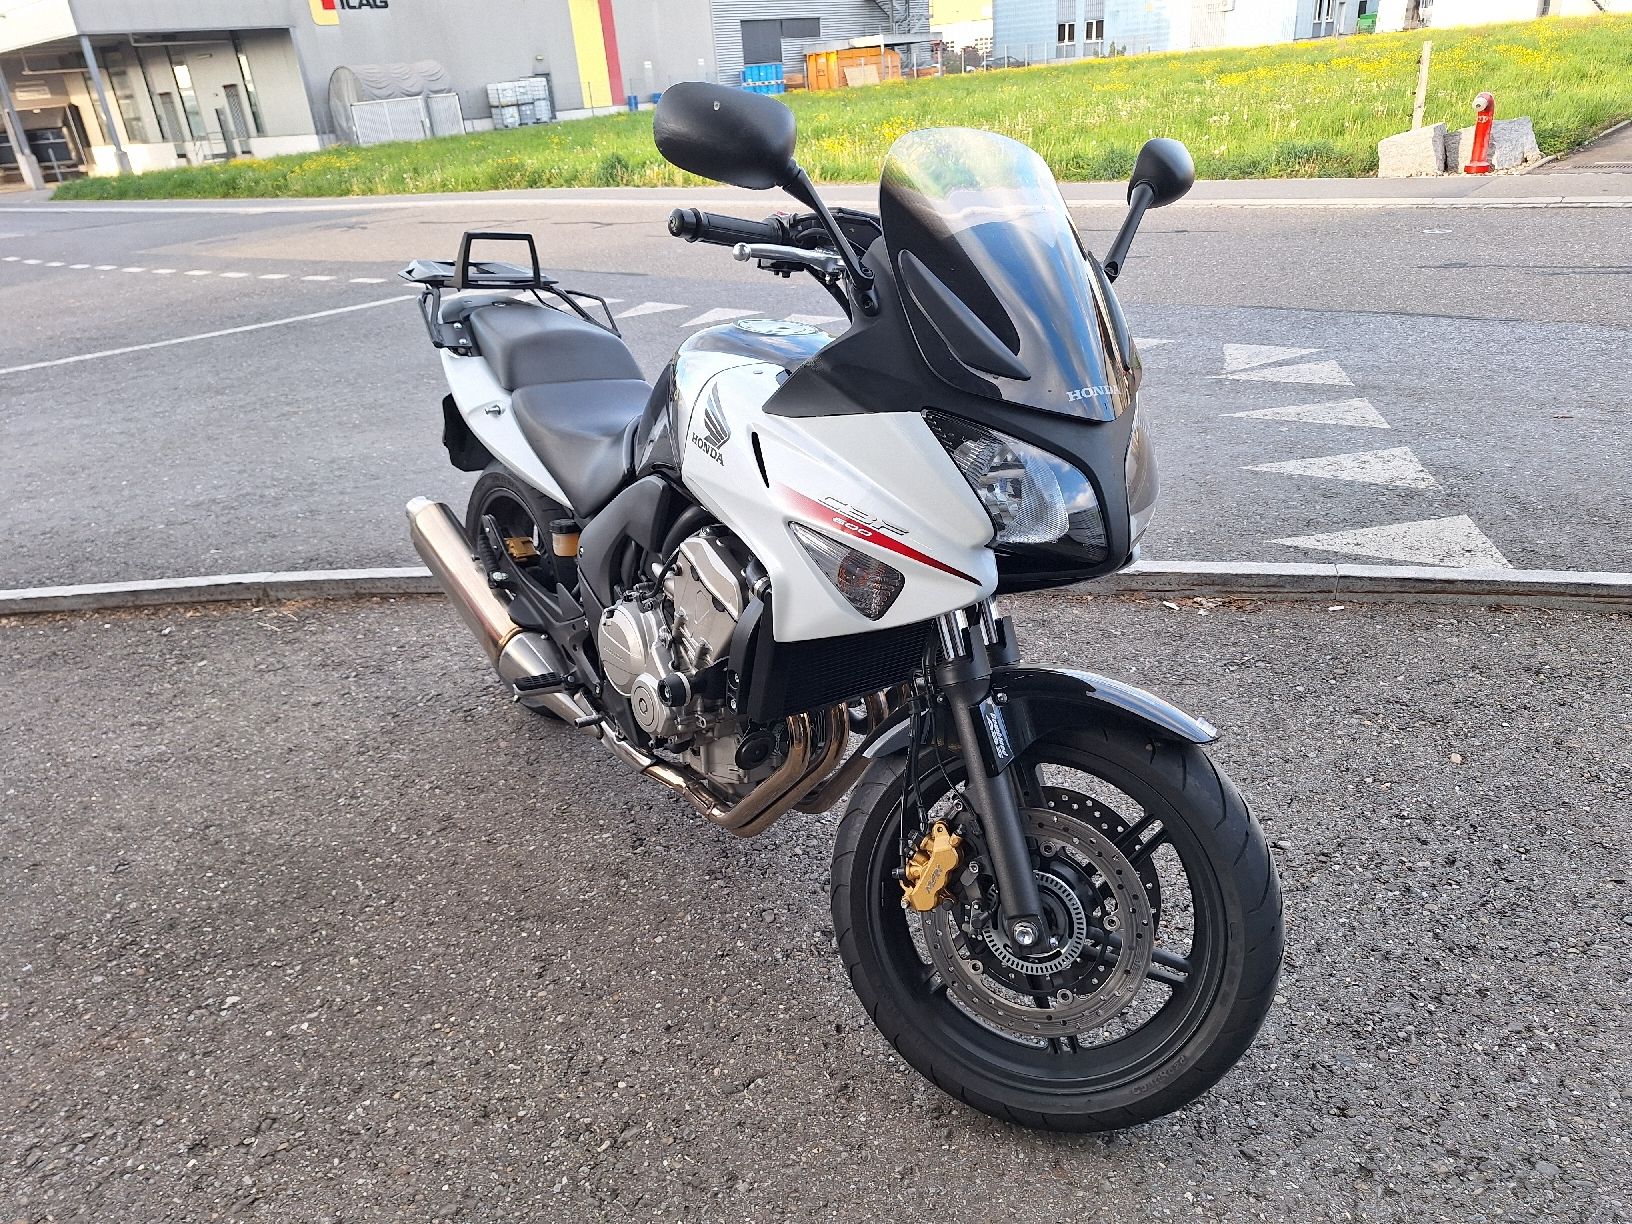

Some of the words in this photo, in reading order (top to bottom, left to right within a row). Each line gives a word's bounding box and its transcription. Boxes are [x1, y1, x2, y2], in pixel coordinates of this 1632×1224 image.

[1066, 384, 1121, 402] HONDA
[691, 431, 725, 467] HONDA
[817, 496, 910, 536] CBF
[832, 516, 873, 537] 600
